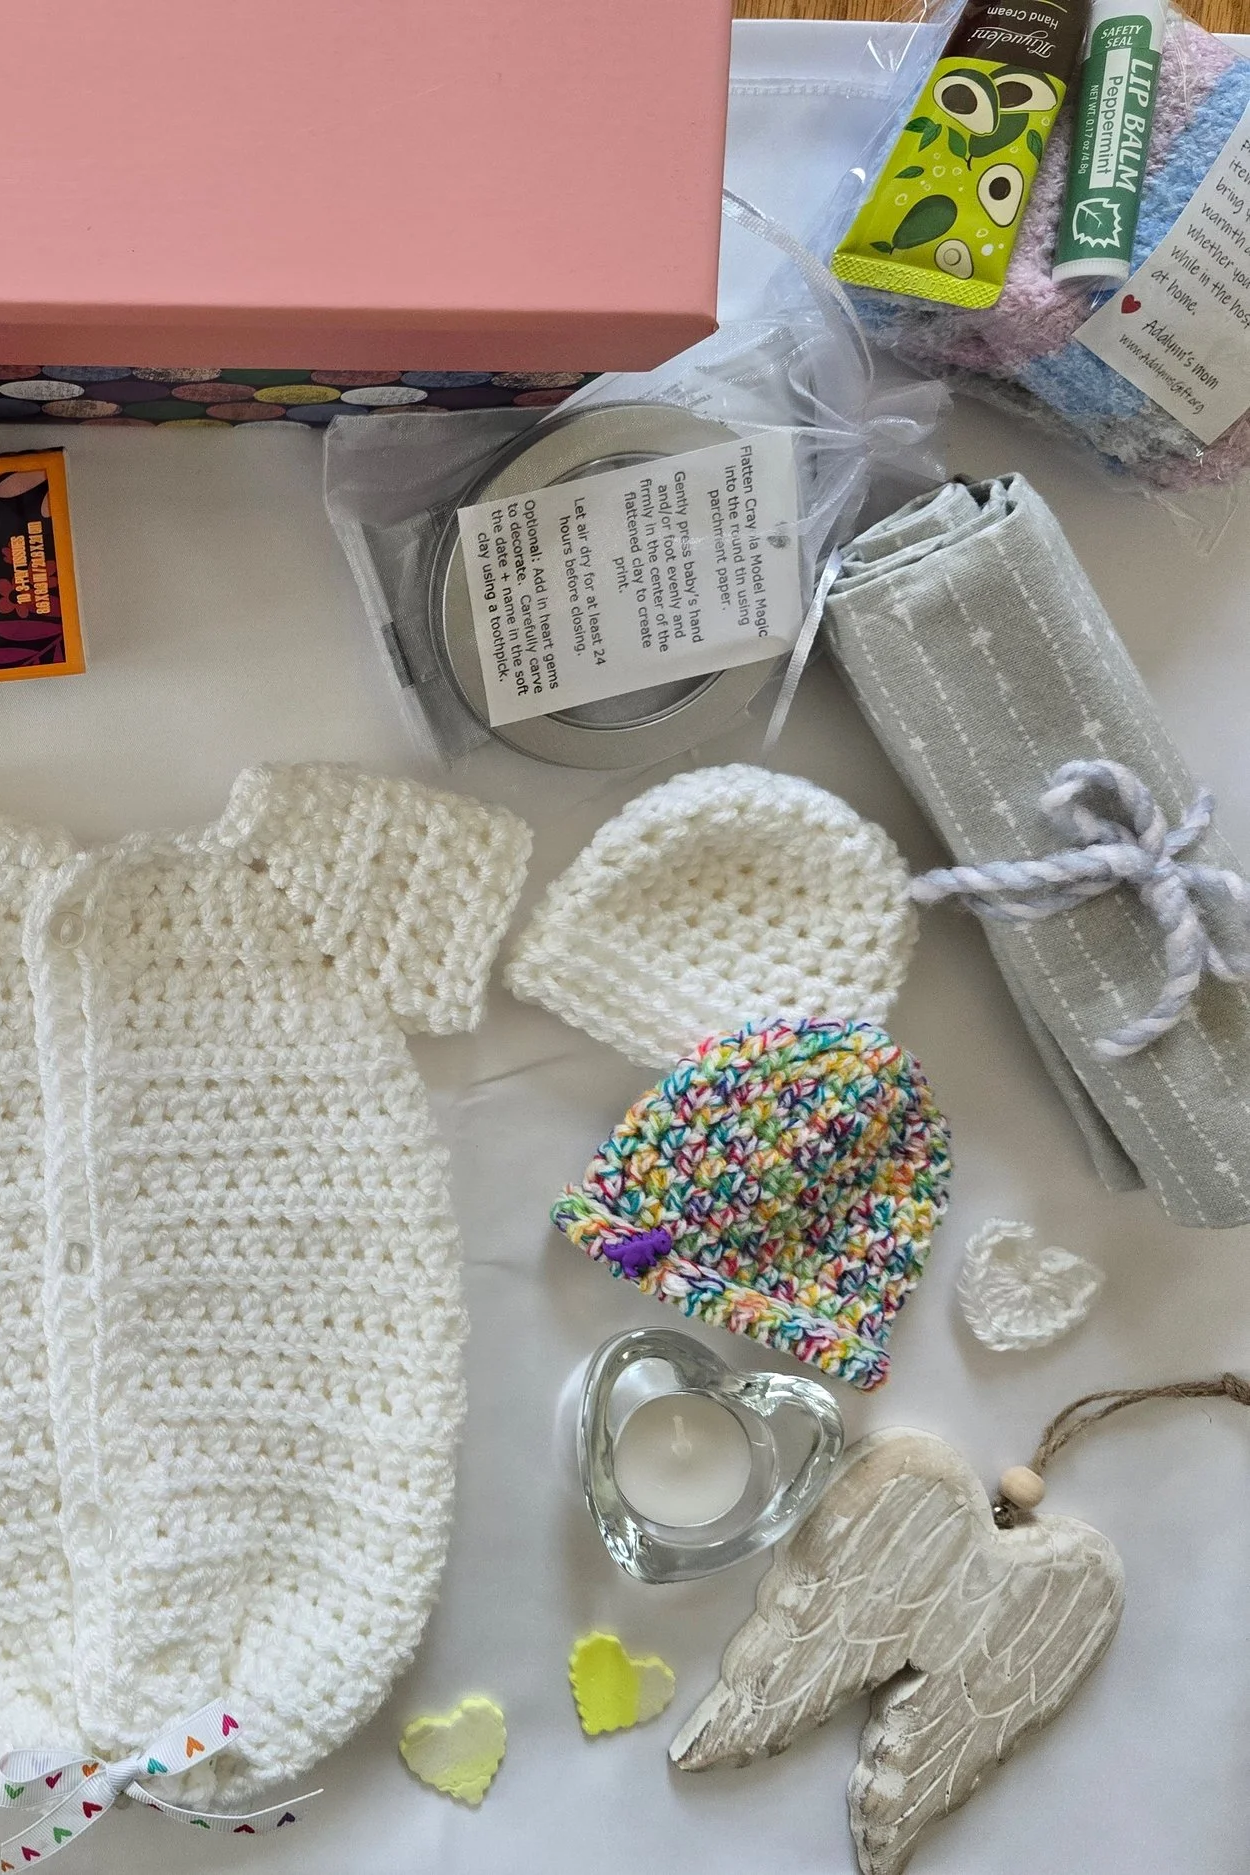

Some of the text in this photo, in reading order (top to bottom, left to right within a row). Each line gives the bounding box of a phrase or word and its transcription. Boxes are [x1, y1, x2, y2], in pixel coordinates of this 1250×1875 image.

[987, 7, 1058, 29] Hand Cream
[1101, 25, 1143, 39] SAFETY
[1105, 36, 1133, 48] SEAL
[1089, 85, 1099, 103] NET
[1085, 119, 1094, 137] 0.17
[1097, 76, 1123, 174] Peppermint
[1115, 58, 1152, 192] LIP BALM
[1083, 140, 1089, 150] oz
[1216, 176, 1244, 214] bring
[1201, 203, 1246, 248] warmth
[1187, 224, 1235, 269] whether
[1151, 270, 1196, 316] at home.
[1170, 245, 1201, 276] while
[1198, 268, 1211, 286] in
[1212, 282, 1232, 305] the
[1191, 363, 1219, 390] mom
[741, 445, 753, 493] Flatten
[674, 471, 688, 515] Gently
[478, 532, 489, 558] clay
[676, 520, 691, 557] press
[482, 564, 495, 600] using
[559, 515, 585, 655] hours before closing.
[574, 497, 606, 665] Let air dry for at least 24
[750, 554, 765, 594] Model
[523, 500, 558, 689] Optional: Add in heart gems
[689, 609, 704, 642] hand
[754, 598, 769, 637] Magic
[490, 616, 509, 681] toothpick.
